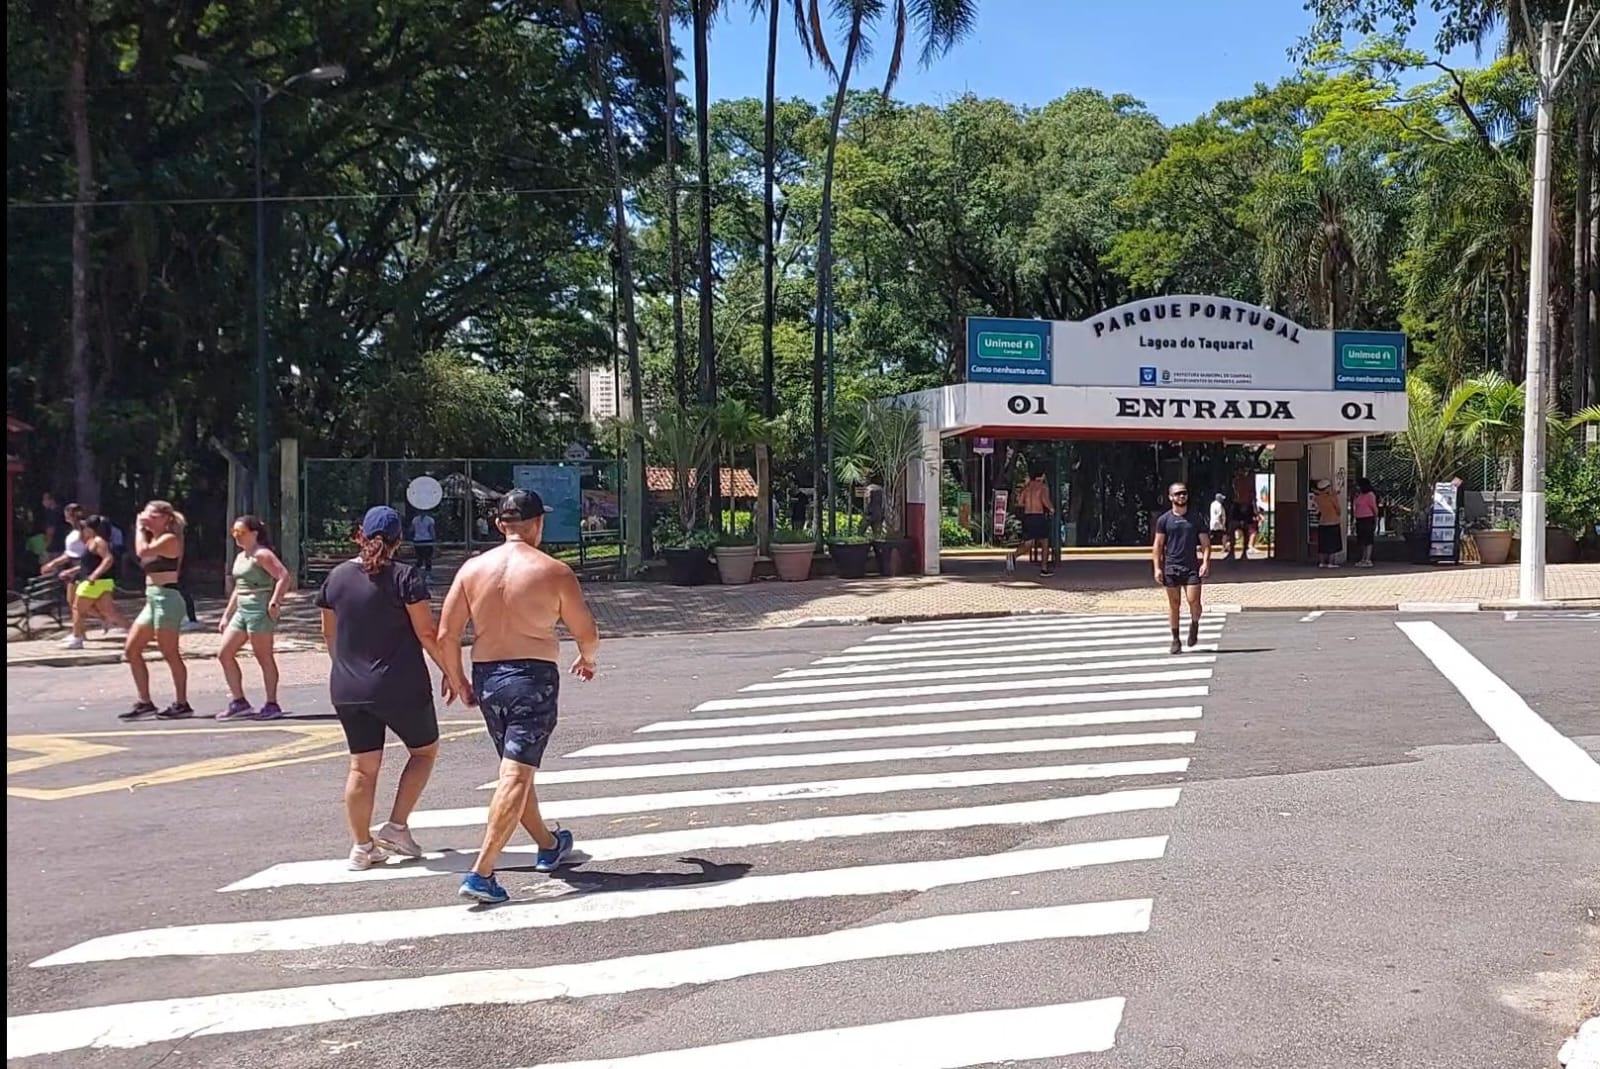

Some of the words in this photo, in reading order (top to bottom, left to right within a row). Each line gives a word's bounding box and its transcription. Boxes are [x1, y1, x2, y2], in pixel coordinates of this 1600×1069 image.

[1093, 303, 1182, 337] PARQUE
[1189, 303, 1300, 344] PORTUGAL
[984, 338, 1022, 349] Unimed
[1139, 336, 1177, 350] Lagoa
[1180, 337, 1195, 348] do
[1199, 337, 1253, 352] Taquaral
[1348, 350, 1381, 359] Unimed
[971, 365, 992, 373] Como
[1007, 395, 1049, 415] 01
[1115, 396, 1296, 420] ENTRADA
[1341, 402, 1376, 420] 01
